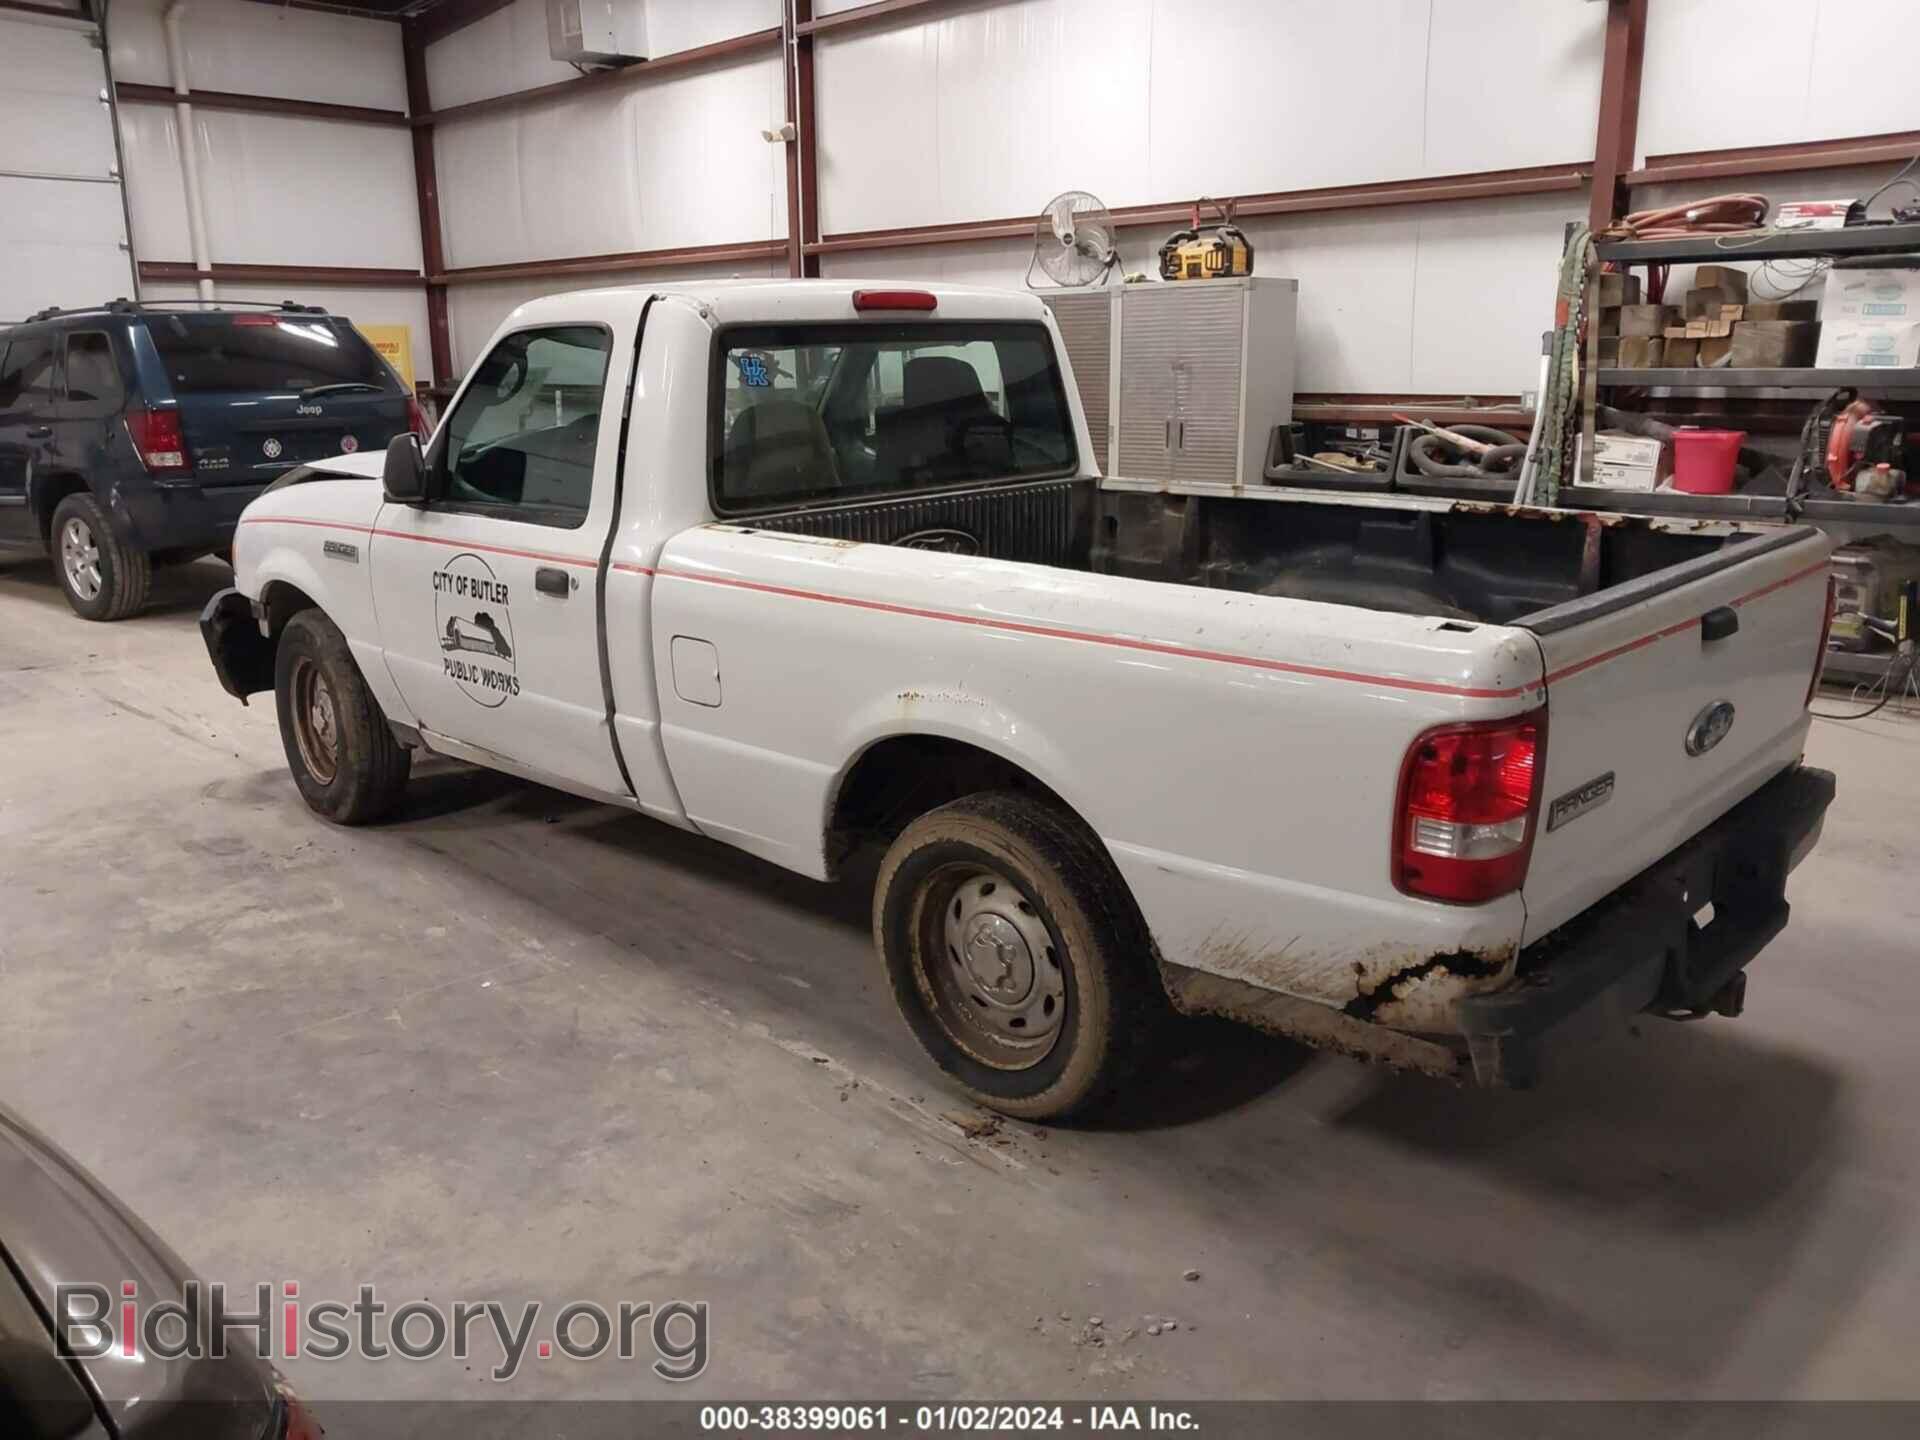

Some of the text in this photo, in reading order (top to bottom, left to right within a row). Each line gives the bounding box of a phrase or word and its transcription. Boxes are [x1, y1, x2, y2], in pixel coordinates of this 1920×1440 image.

[432, 570, 510, 606] CITY OF BUTLER
[442, 657, 521, 697] PUBLIC WORKS
[1553, 777, 1615, 822] RANGER
